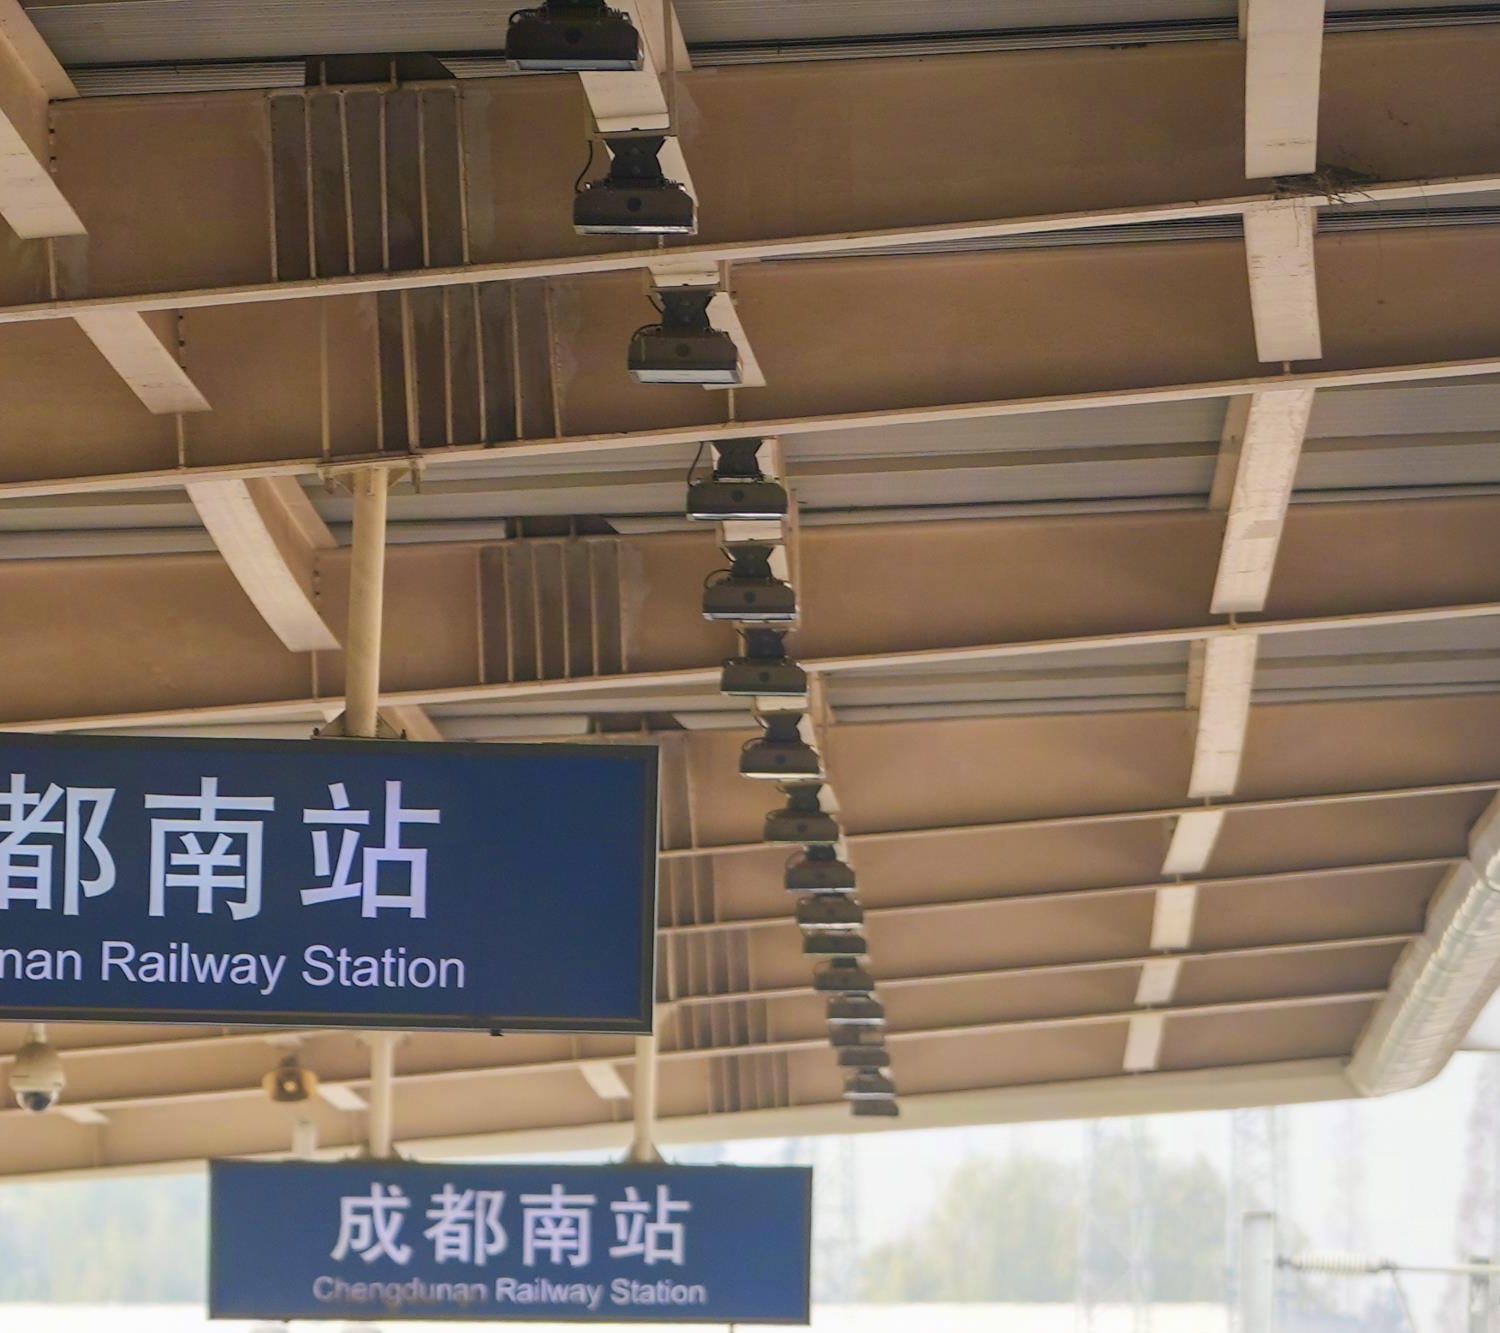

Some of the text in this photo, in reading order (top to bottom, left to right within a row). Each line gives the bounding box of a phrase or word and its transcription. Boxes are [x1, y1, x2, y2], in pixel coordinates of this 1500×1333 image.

[101, 941, 286, 995] Railway
[302, 944, 465, 988] Station
[330, 1182, 691, 1267] 成都南站
[312, 1276, 707, 1311] Chengdunan Railway Station
